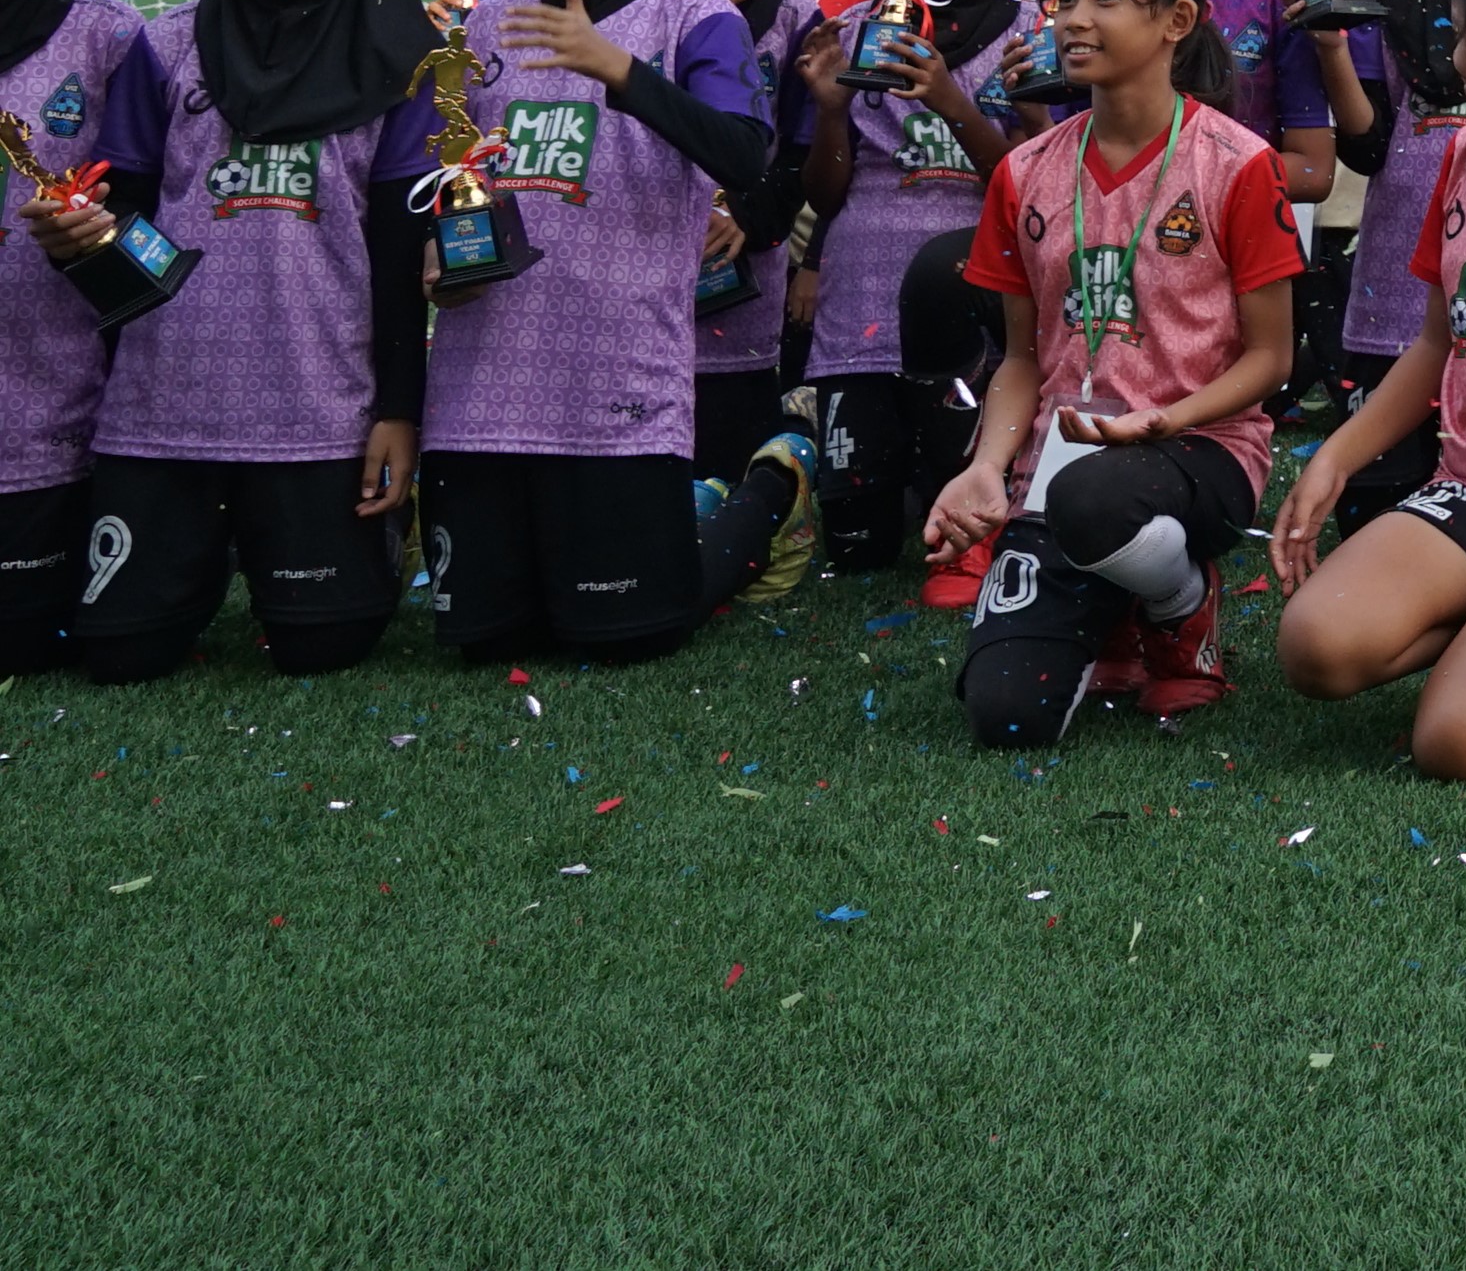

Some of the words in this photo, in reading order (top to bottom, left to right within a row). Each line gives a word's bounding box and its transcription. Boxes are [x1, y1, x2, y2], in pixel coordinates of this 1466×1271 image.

[509, 107, 586, 144] Milk
[514, 142, 583, 176] Life
[926, 143, 977, 172] Lif
[251, 164, 313, 196] Life
[495, 179, 528, 189] SOCCER
[529, 179, 574, 192] CHALLENGE
[232, 198, 263, 209] SOCCER
[263, 198, 307, 211] CHALLENGE
[1, 552, 67, 570] ortuseight
[82, 515, 132, 605] 9
[273, 566, 337, 581] ortuseight
[577, 578, 638, 593] ortuseight
